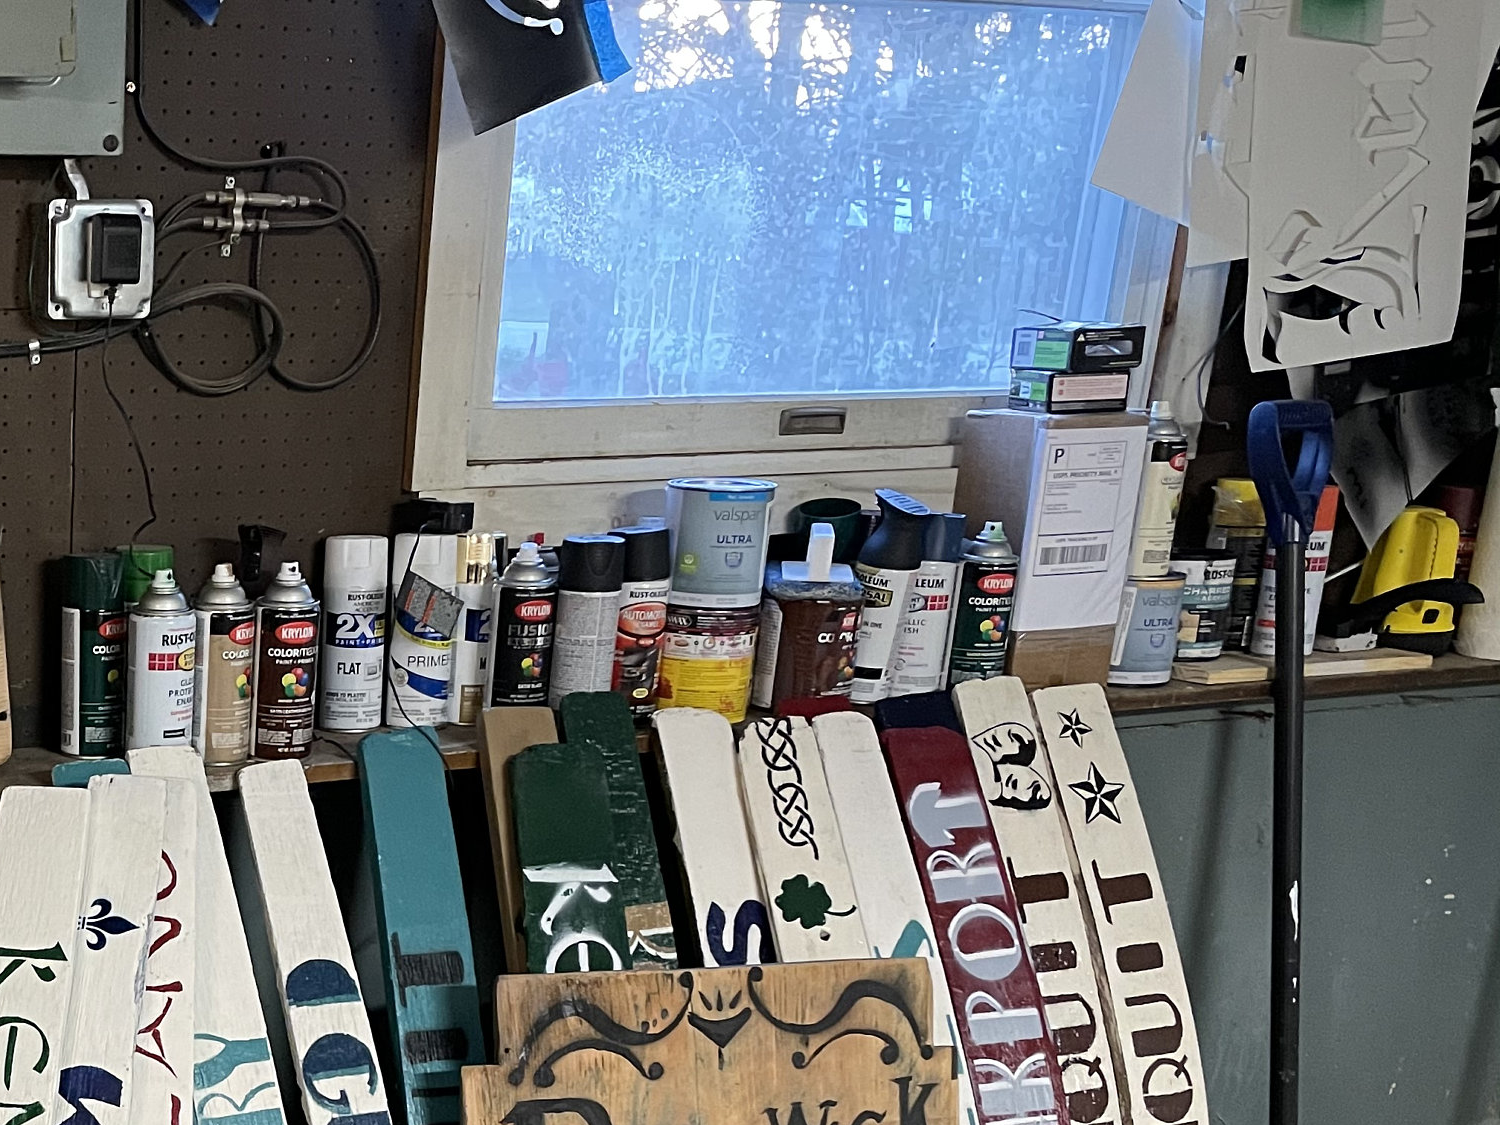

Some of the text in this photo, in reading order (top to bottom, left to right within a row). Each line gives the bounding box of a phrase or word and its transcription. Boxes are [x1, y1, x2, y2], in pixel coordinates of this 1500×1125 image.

[1053, 448, 1065, 464] P
[713, 506, 761, 525] valspar
[716, 535, 752, 544] ULTRA
[336, 614, 375, 639] 2X
[1143, 618, 1174, 627] ULTRA
[281, 627, 314, 639] KRYLON
[337, 662, 361, 675] FLAT
